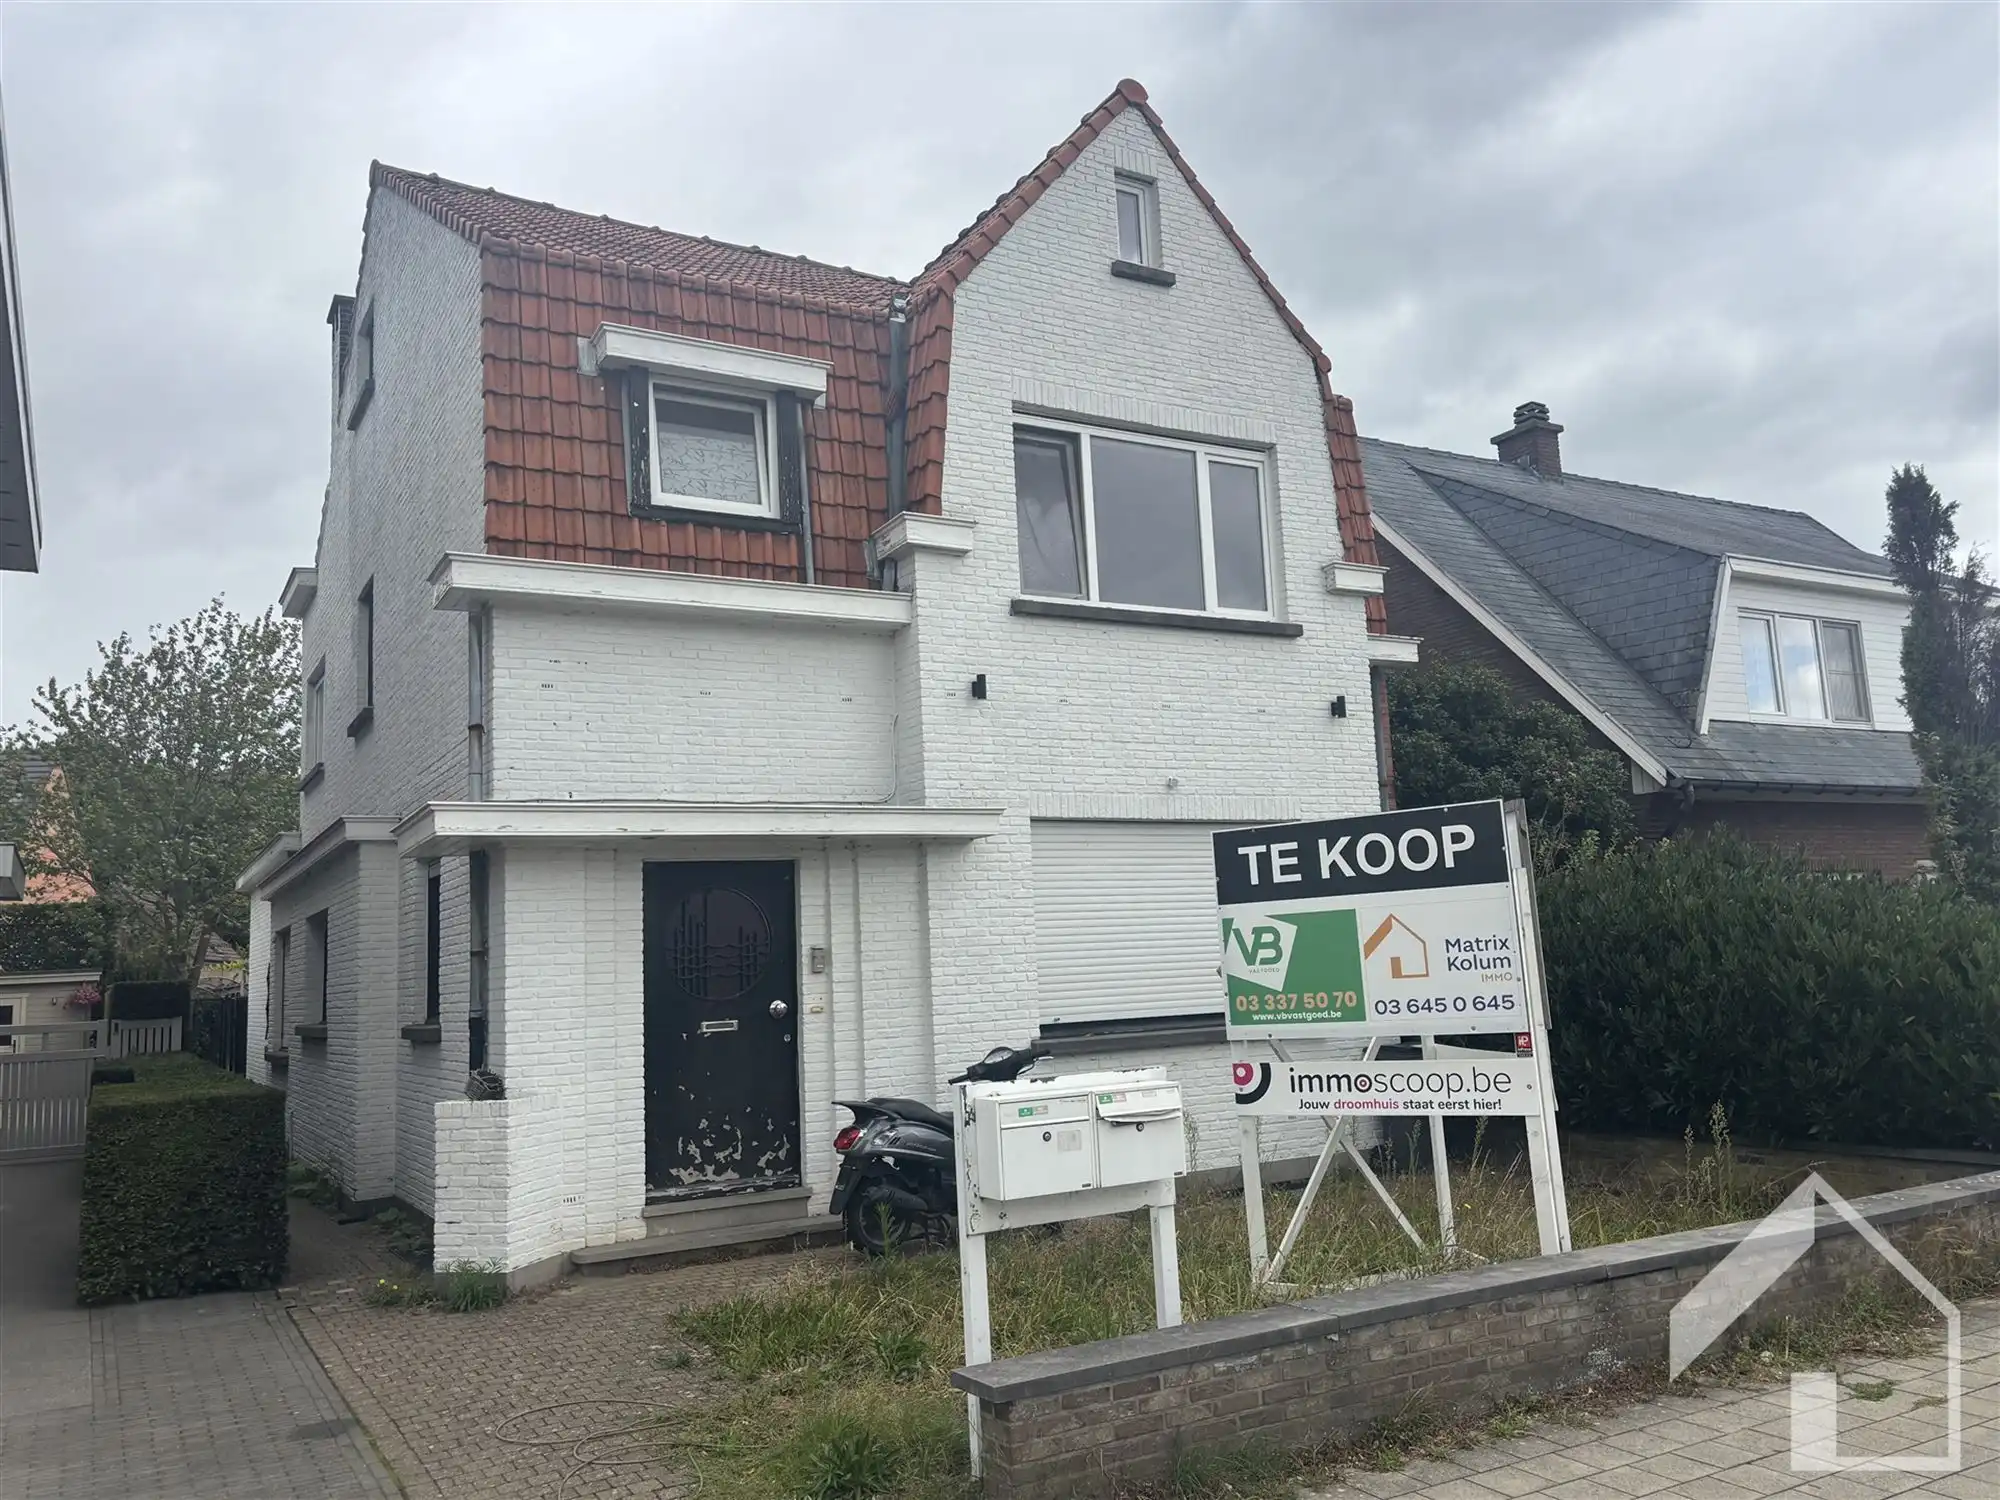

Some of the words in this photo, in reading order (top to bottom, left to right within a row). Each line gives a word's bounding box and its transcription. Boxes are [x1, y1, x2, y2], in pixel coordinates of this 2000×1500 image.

[1238, 841, 1302, 885] TE
[1318, 824, 1475, 879] KOOP
[1232, 925, 1283, 966] VB
[1445, 935, 1510, 953] Matrix
[1447, 954, 1511, 972] Kolum
[1481, 972, 1513, 983] IMMO
[1236, 995, 1259, 1011] 03
[1264, 993, 1298, 1010] 337
[1303, 992, 1328, 1008] 50
[1333, 991, 1357, 1008] 70
[1374, 999, 1401, 1015] 03
[1406, 997, 1447, 1014] 645
[1453, 996, 1467, 1012] 0
[1472, 994, 1515, 1011] 645
[1252, 1010, 1342, 1021] www.vbvastgoed.be
[1289, 1066, 1511, 1099] immoscoop.be
[1299, 1099, 1330, 1110] Jouw
[1334, 1098, 1399, 1110] droomhuis
[1402, 1099, 1434, 1110] staat
[1438, 1099, 1470, 1110] eerst
[1473, 1099, 1502, 1110] hier!
